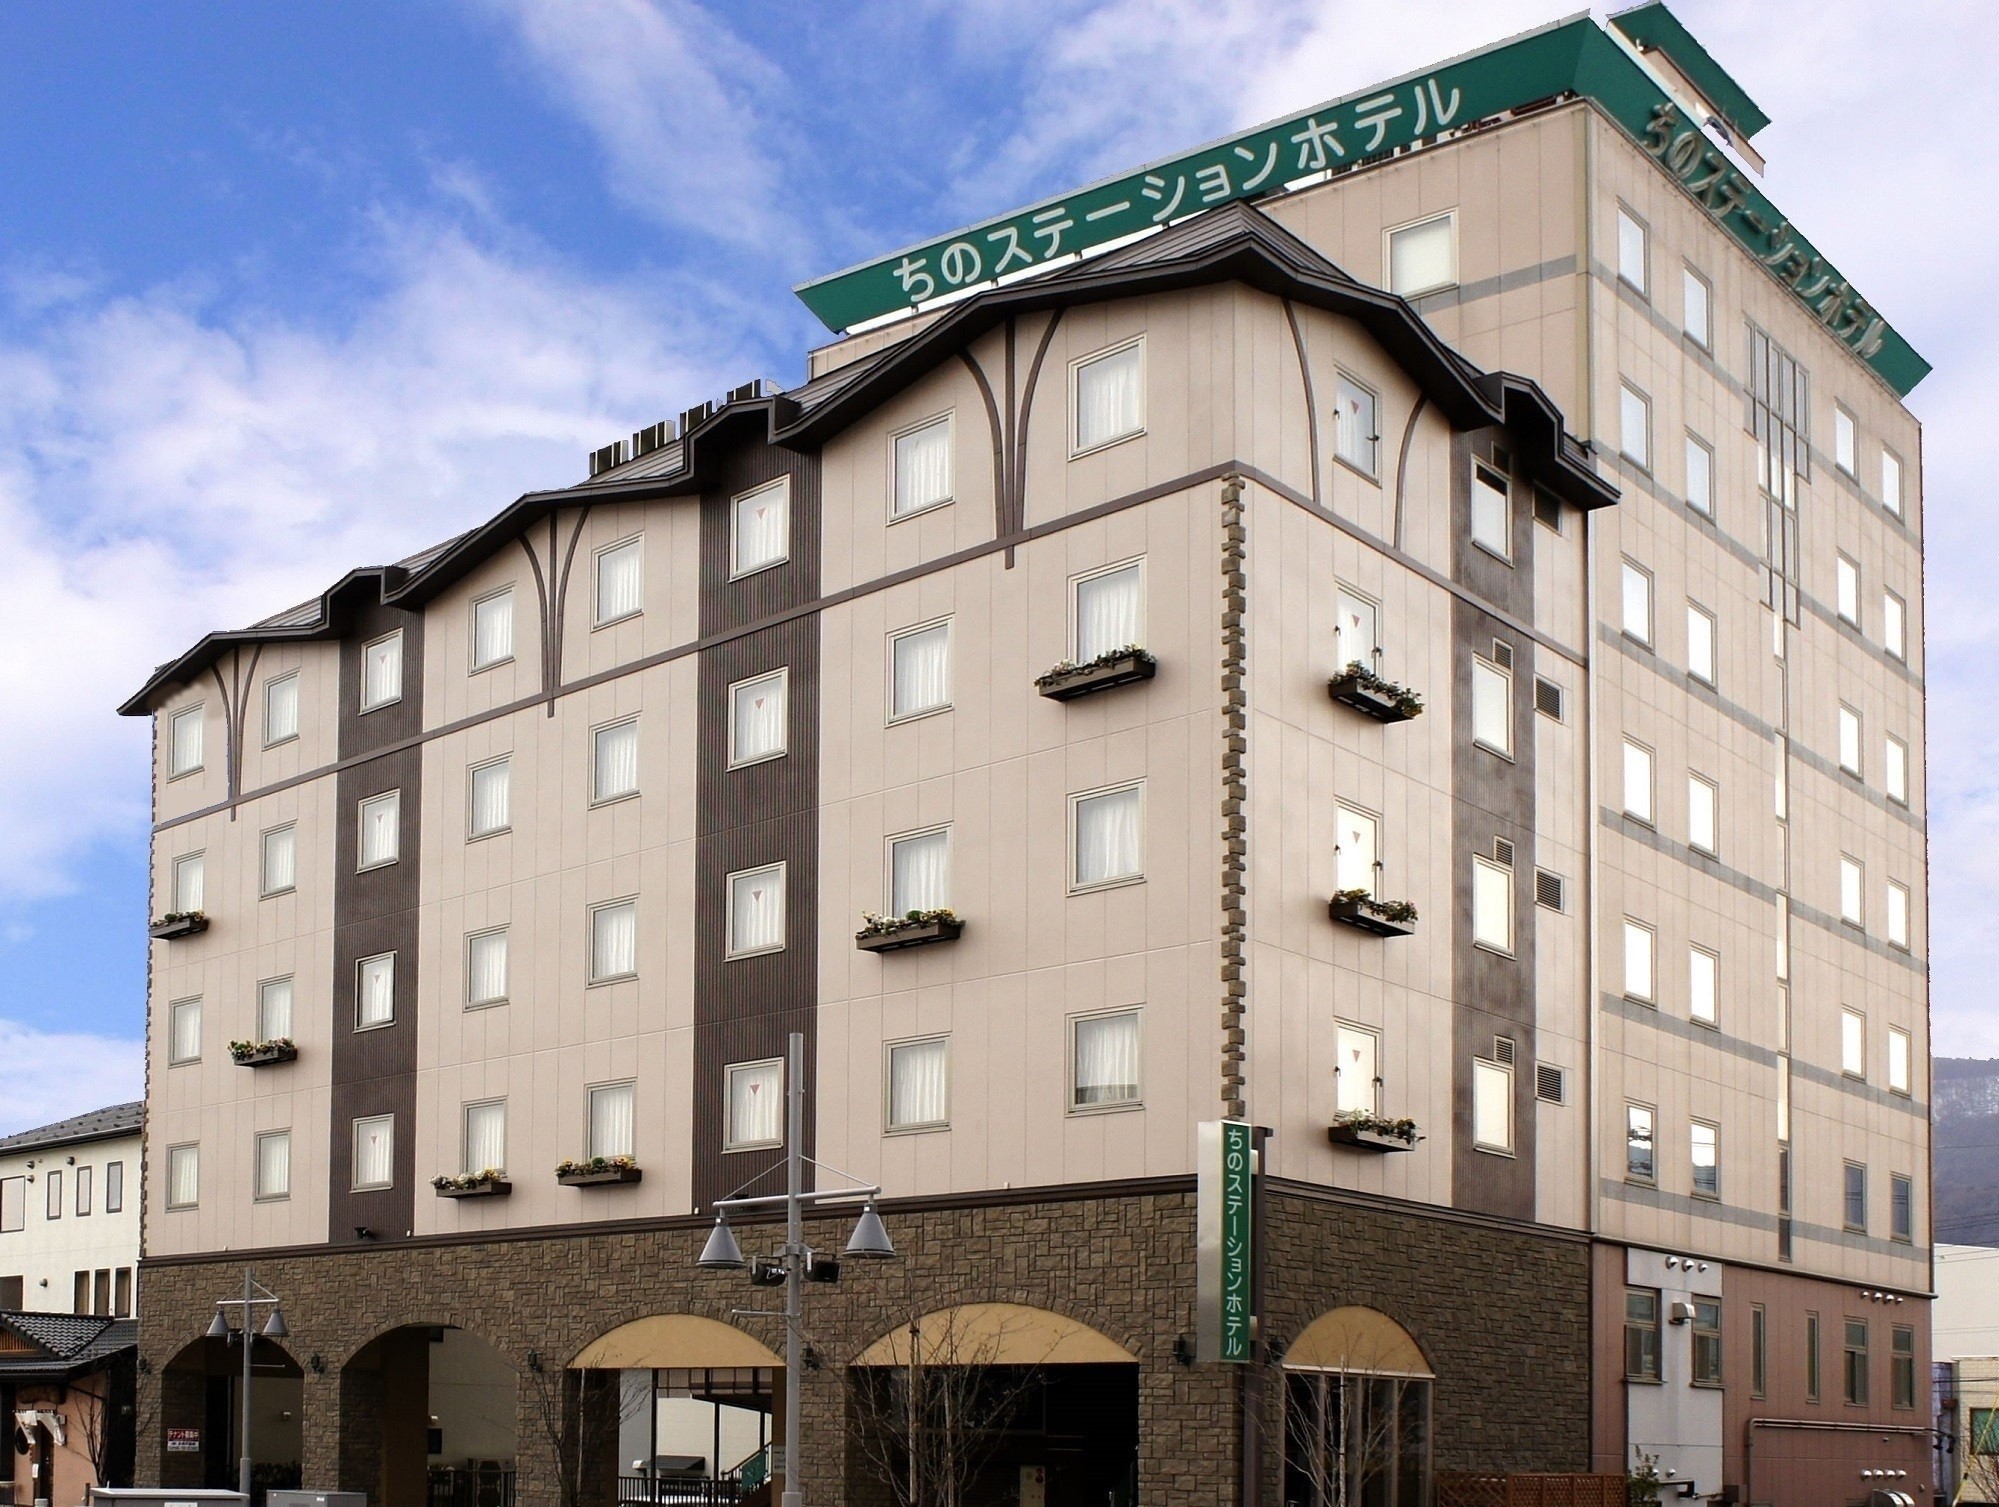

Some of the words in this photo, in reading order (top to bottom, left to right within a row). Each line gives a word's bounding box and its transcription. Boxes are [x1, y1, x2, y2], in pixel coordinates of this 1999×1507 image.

[892, 78, 1461, 303] ちのステーションホテル
[1226, 1128, 1243, 1356] ちのステーションホテル
